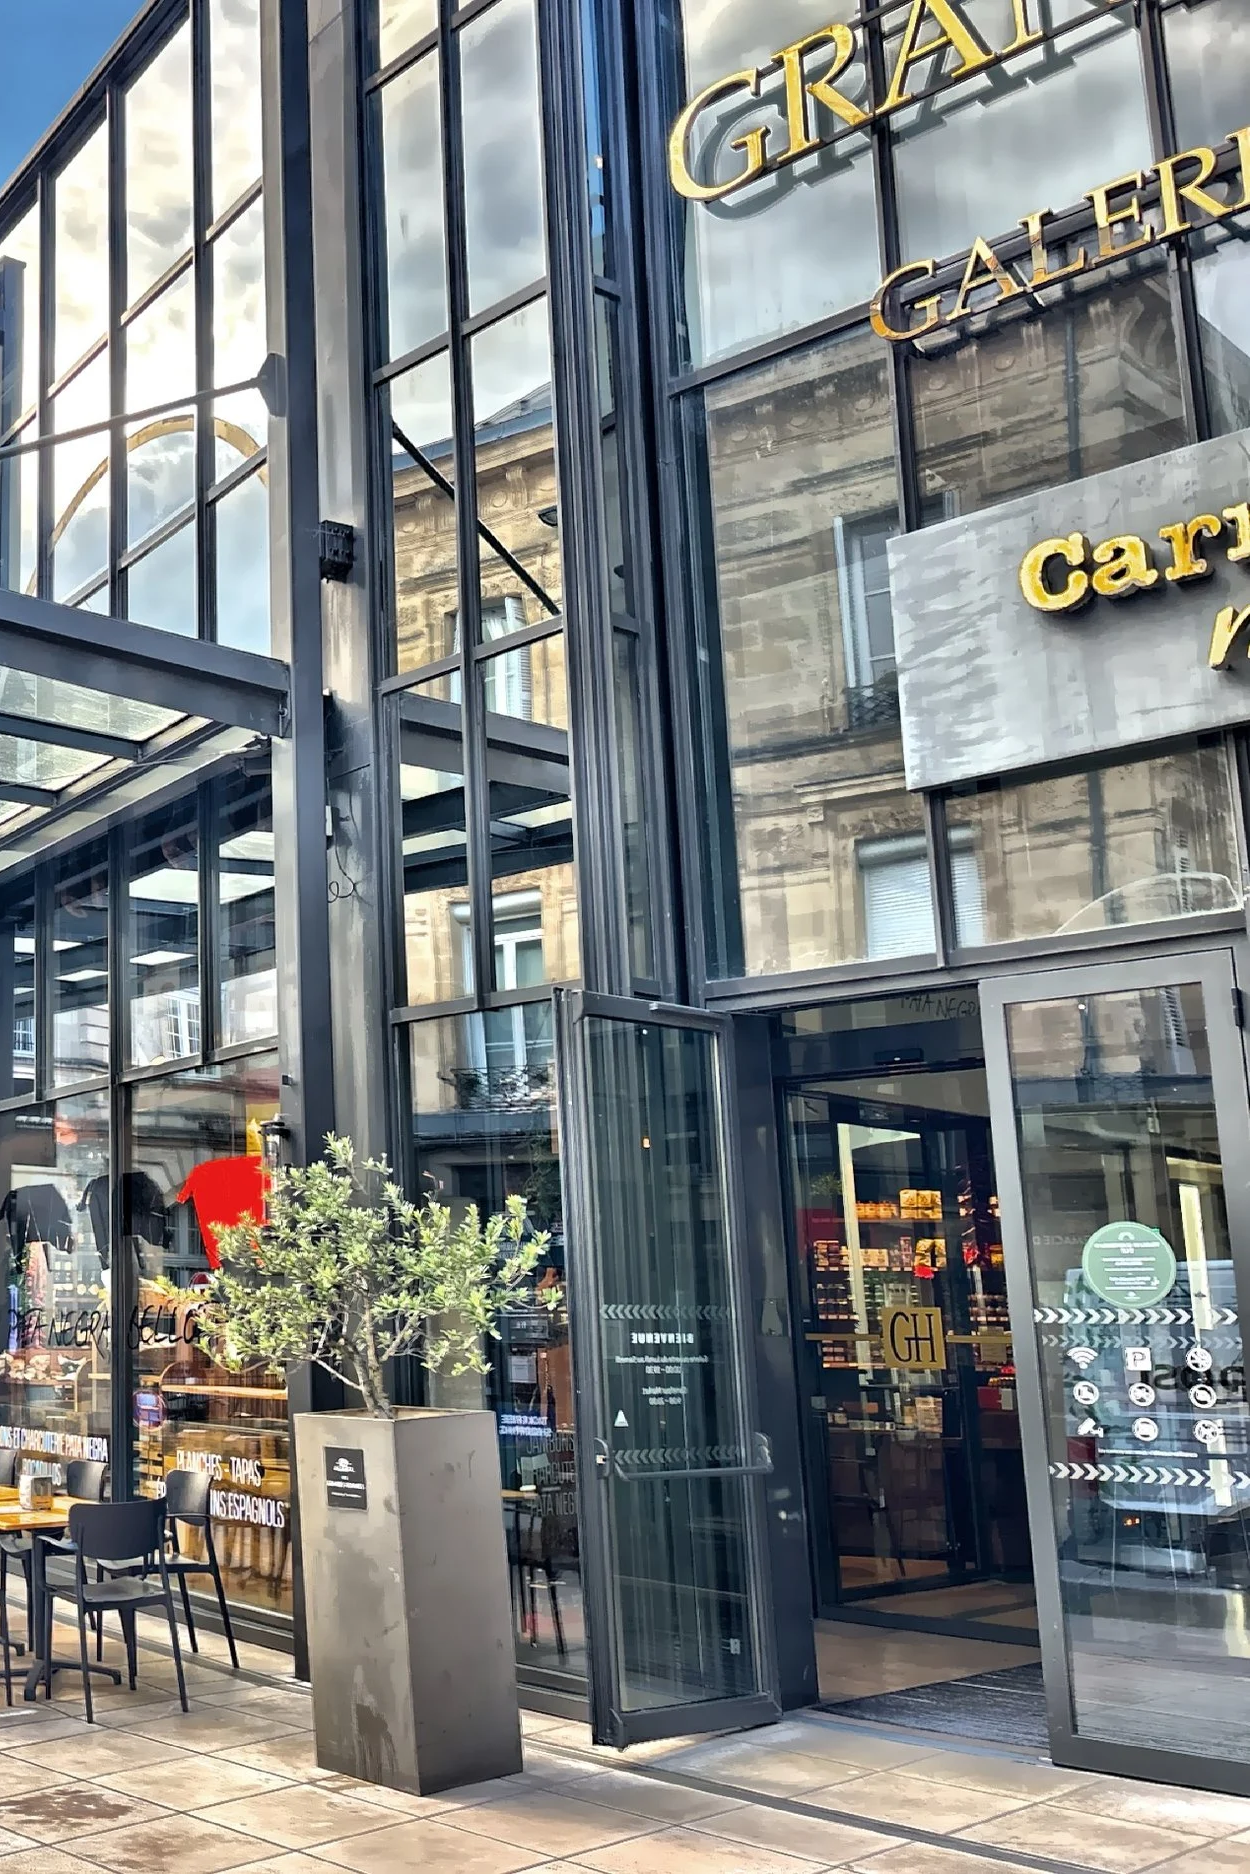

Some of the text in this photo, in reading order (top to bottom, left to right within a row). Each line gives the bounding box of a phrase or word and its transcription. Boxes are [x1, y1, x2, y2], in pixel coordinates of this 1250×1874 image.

[890, 1311, 937, 1362] GH
[83, 1436, 108, 1462] NEGRA
[176, 1450, 223, 1481] PLANCHES
[230, 1456, 262, 1487] TAPAS
[228, 1492, 285, 1528] ESPAGNOLS
